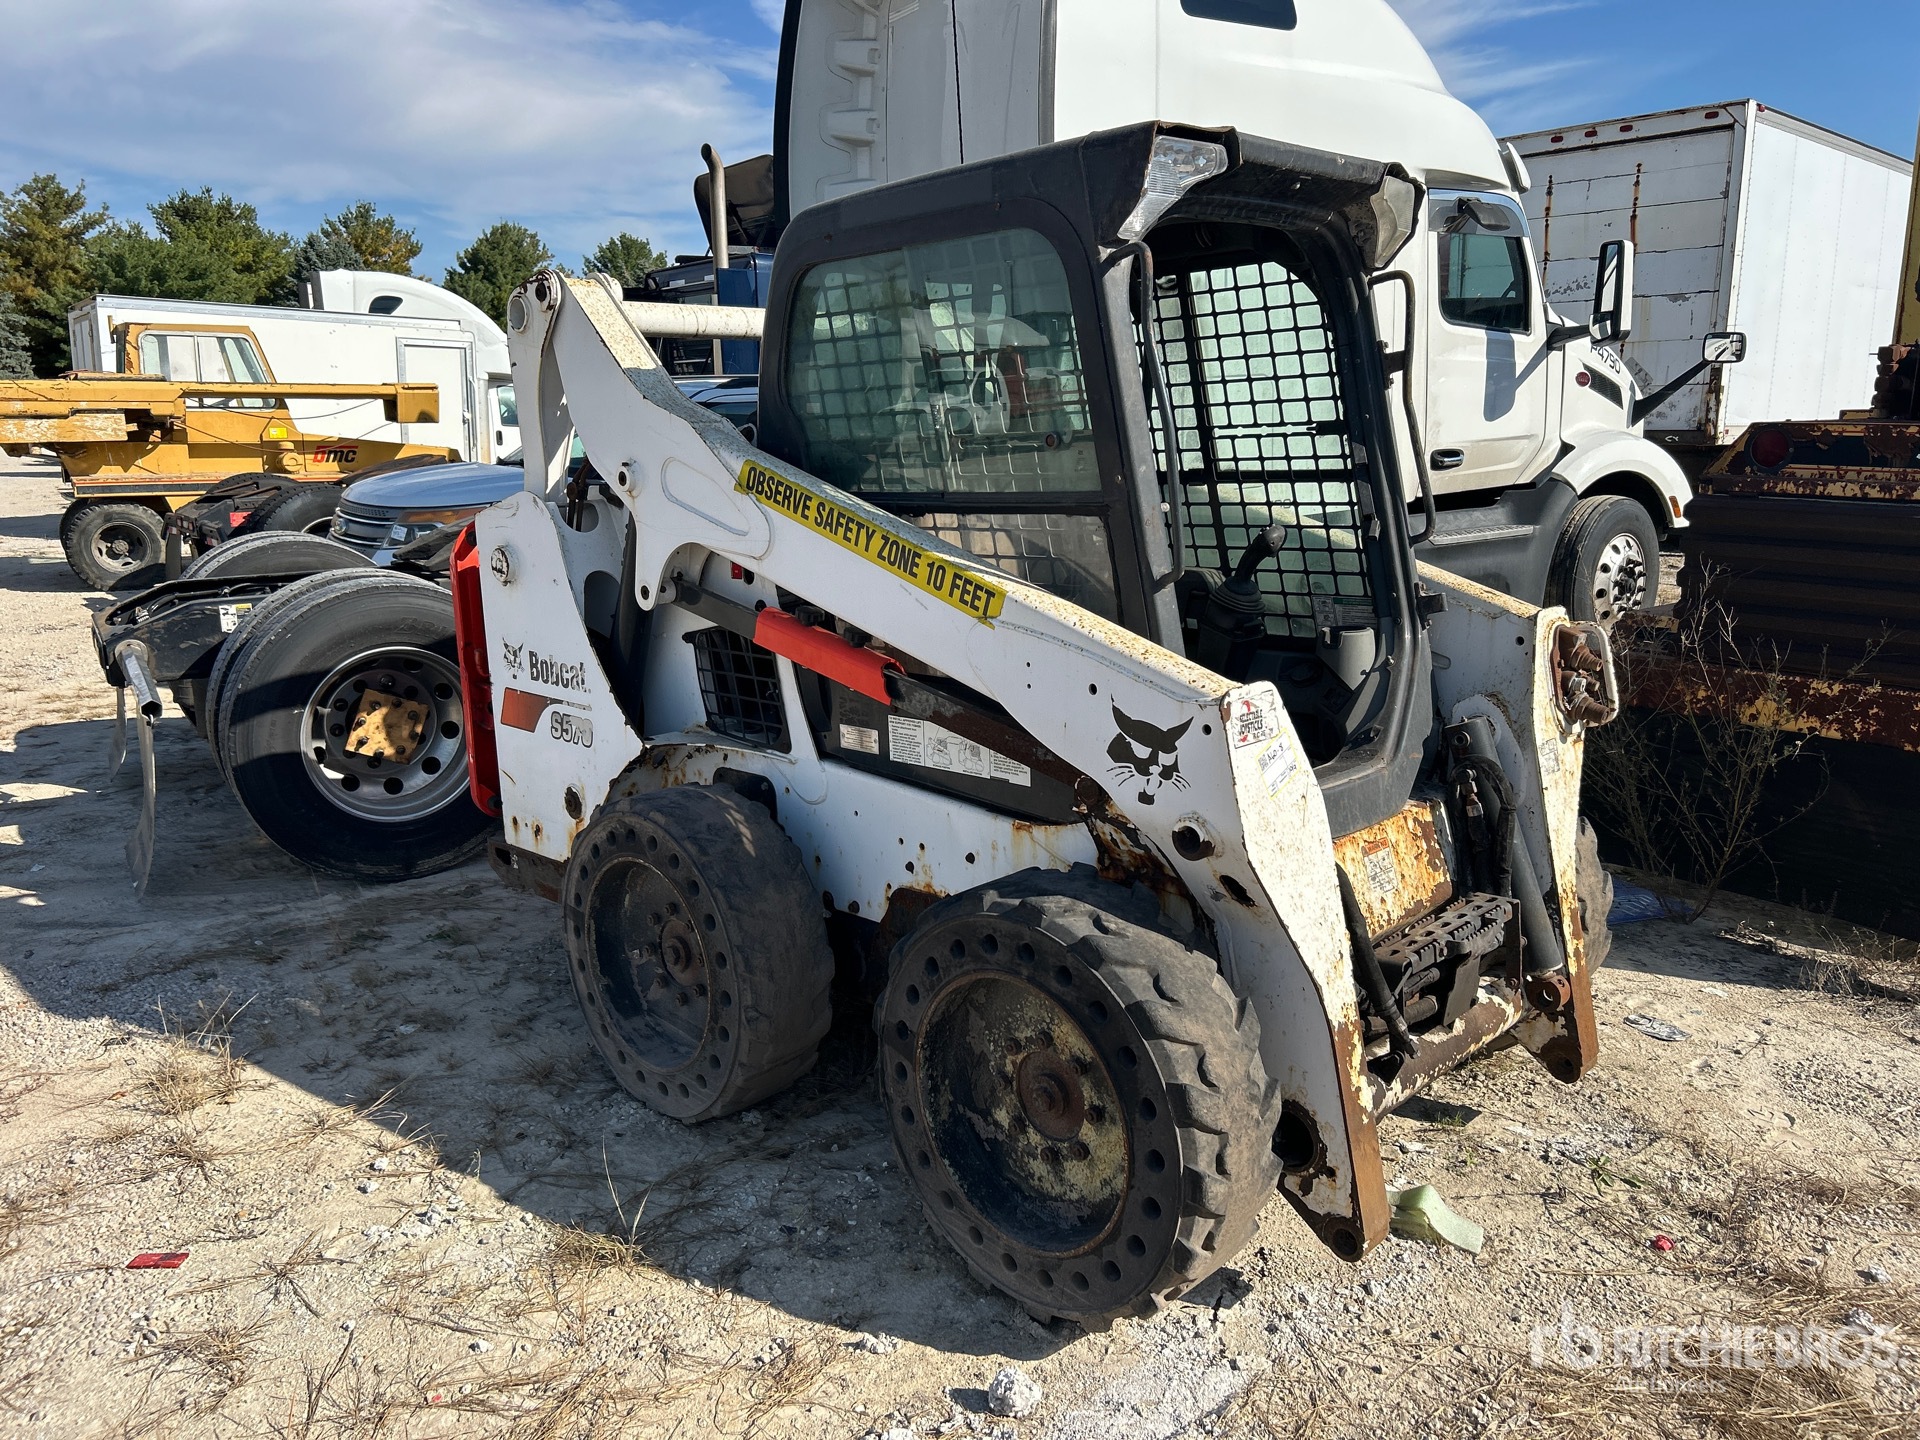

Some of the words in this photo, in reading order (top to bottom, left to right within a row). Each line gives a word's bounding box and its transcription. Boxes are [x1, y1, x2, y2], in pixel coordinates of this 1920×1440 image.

[746, 466, 813, 521] OBSERVE
[814, 501, 877, 552] SAFETY
[877, 533, 922, 579] ZONE
[926, 561, 947, 592] 10
[948, 571, 996, 617] FEET
[528, 650, 587, 693] Bobcat
[550, 711, 594, 748] S570
